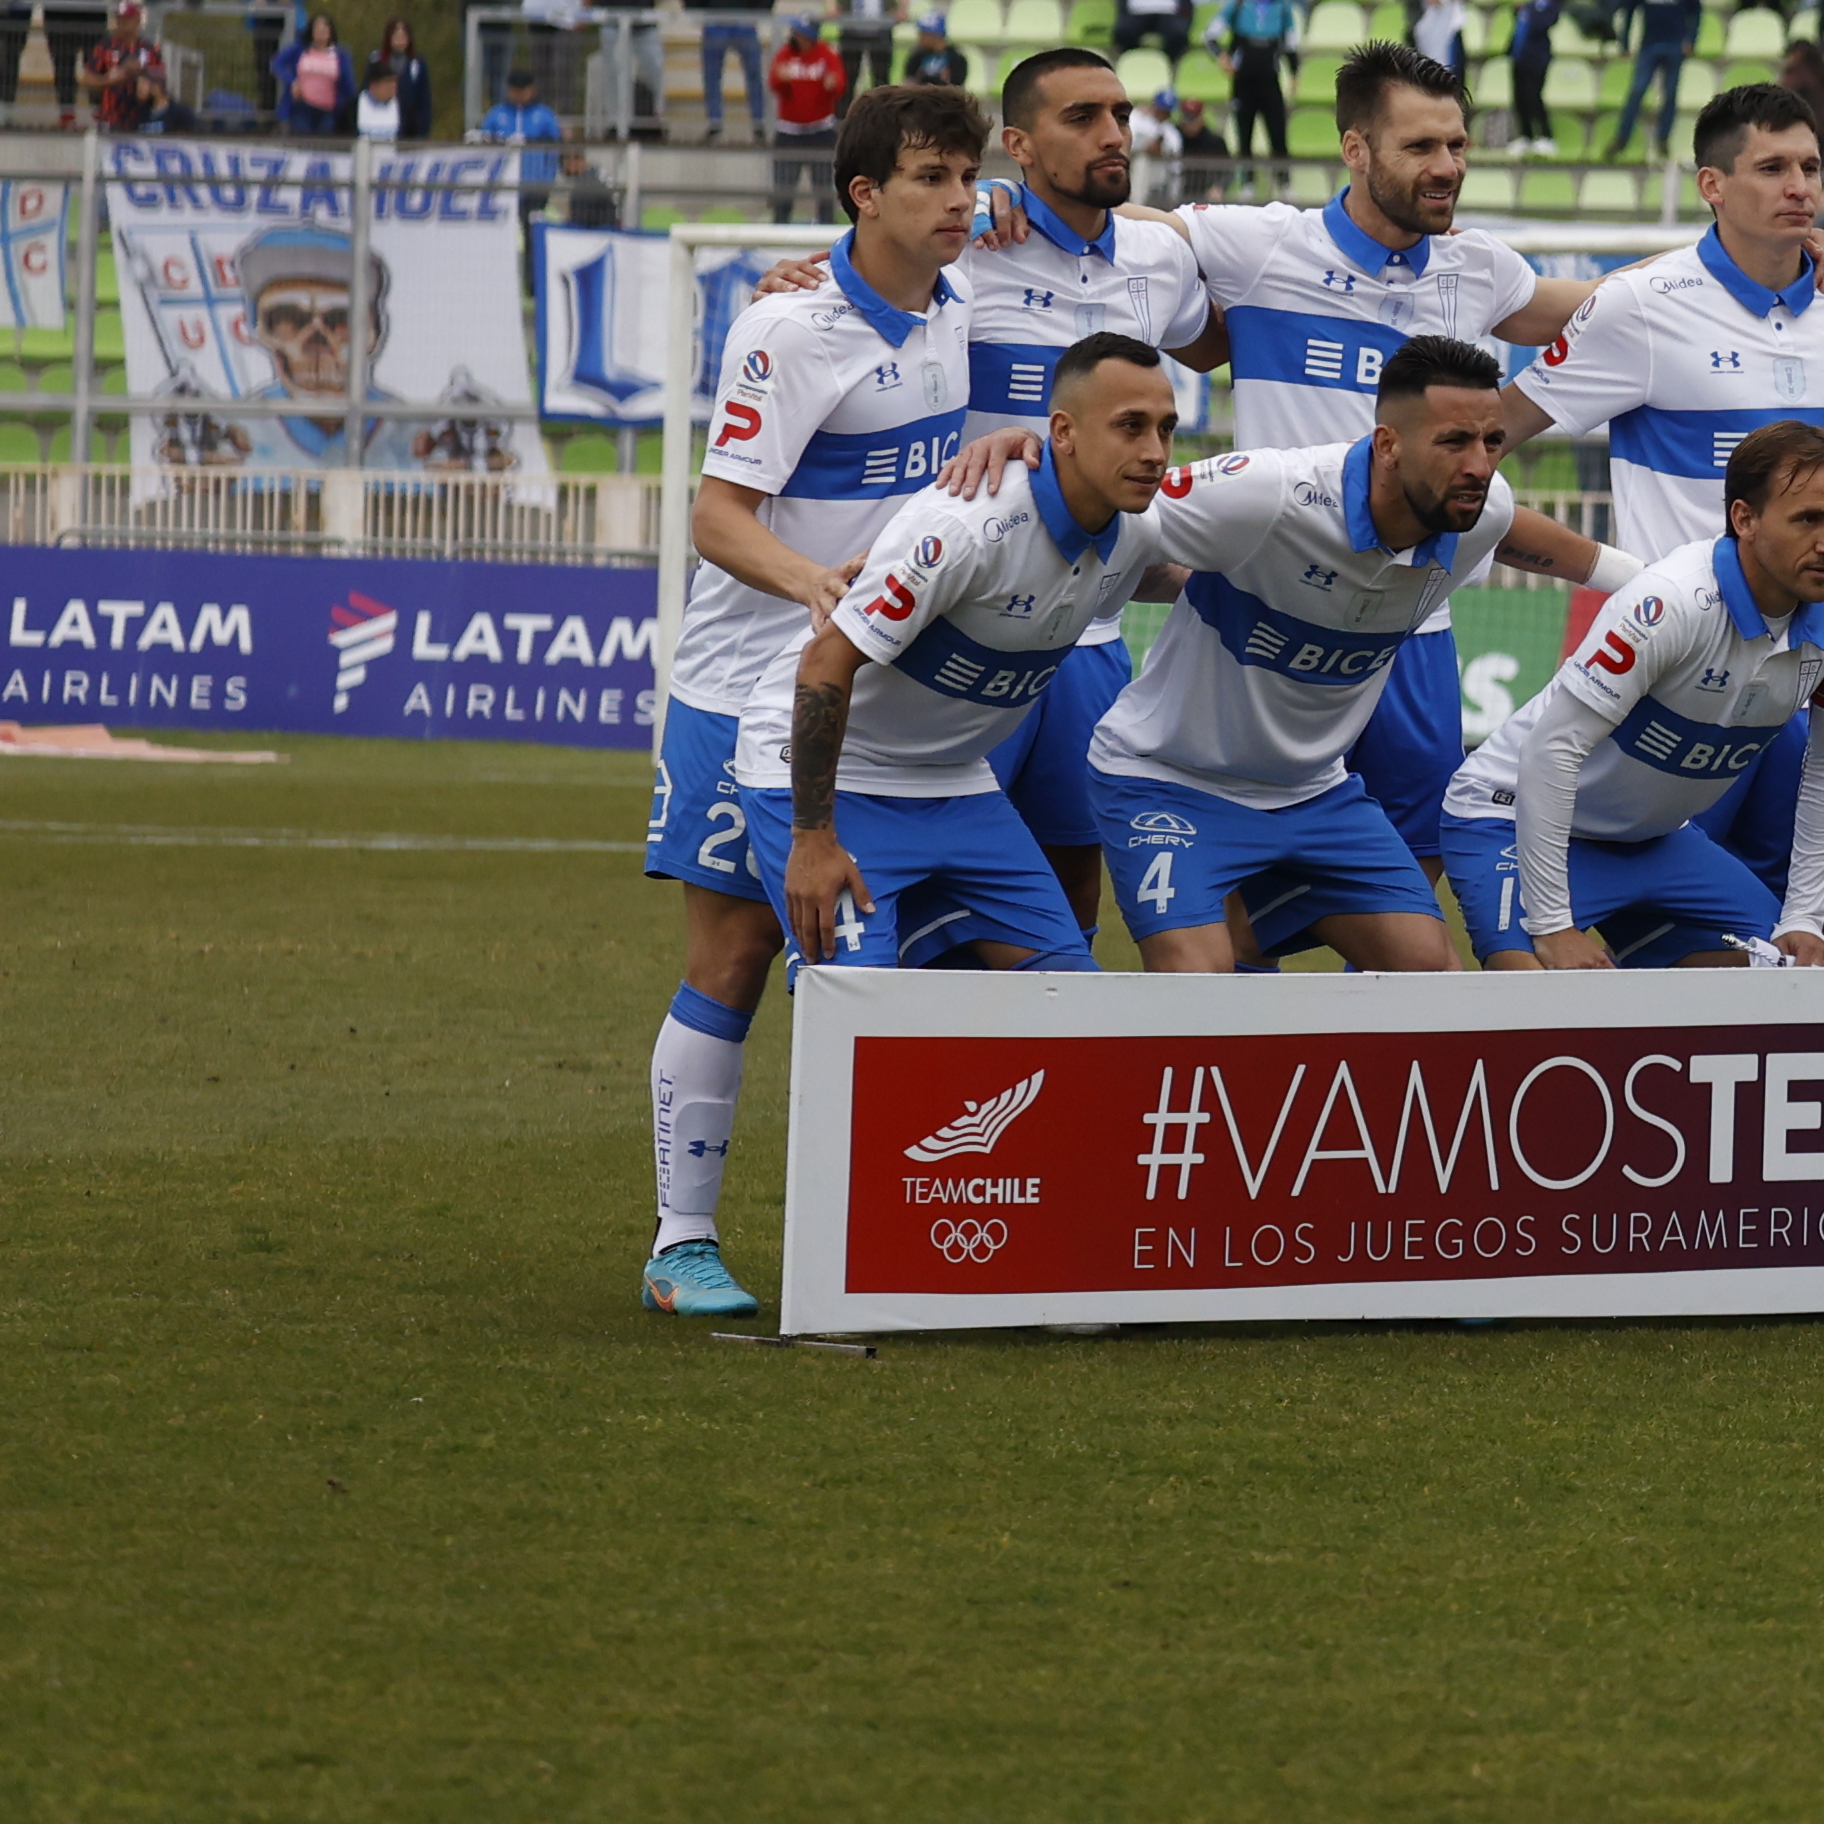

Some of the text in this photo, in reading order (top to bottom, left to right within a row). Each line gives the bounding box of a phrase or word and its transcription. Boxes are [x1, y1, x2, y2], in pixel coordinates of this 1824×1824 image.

[1650, 276, 1703, 294] Midea
[983, 512, 1029, 542] Midea
[9, 596, 253, 655] LATAM
[411, 609, 659, 669] LATAM
[1288, 642, 1396, 675] BICE
[2, 669, 247, 711] AIRLINES
[403, 681, 656, 725] AIRLINES
[1128, 835, 1195, 849] CHERY
[1137, 851, 1175, 914] 4
[903, 1176, 1040, 1206] TEAMCHILE
[1133, 1227, 1197, 1270] EN
[1225, 1221, 1316, 1267] LOS
[1337, 1214, 1537, 1264] JUEGOS
